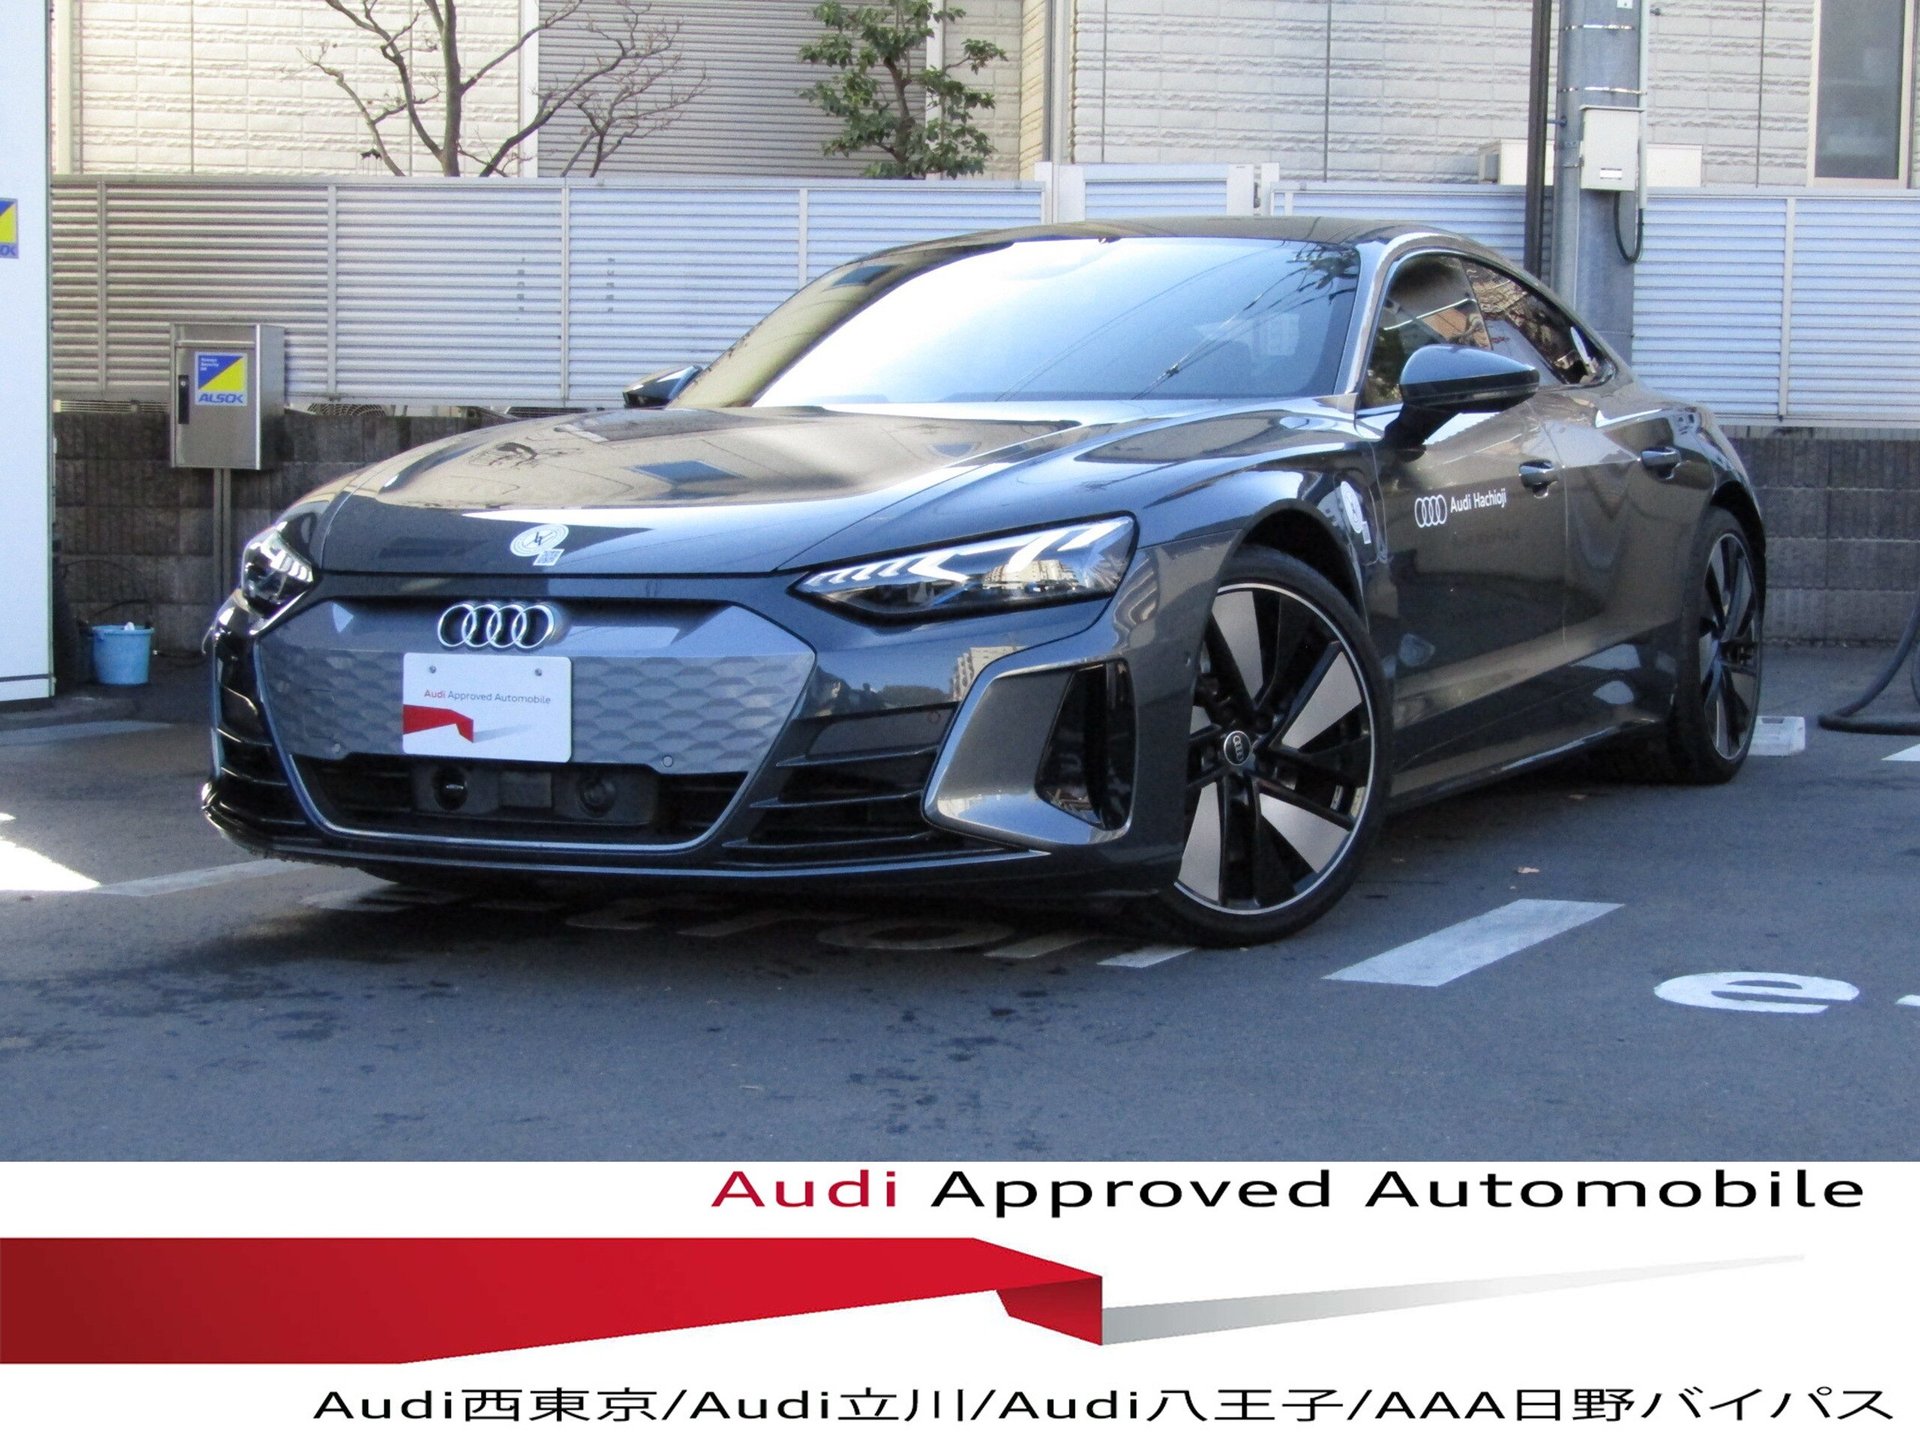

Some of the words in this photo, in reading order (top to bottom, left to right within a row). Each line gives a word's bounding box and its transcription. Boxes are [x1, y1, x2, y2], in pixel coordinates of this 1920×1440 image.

[199, 393, 244, 404] ALSOK
[1450, 494, 1472, 513] Audi
[1472, 487, 1507, 509] Hachioji
[424, 689, 446, 699] Audi
[447, 690, 493, 702] Approved
[494, 693, 552, 705] Automobile
